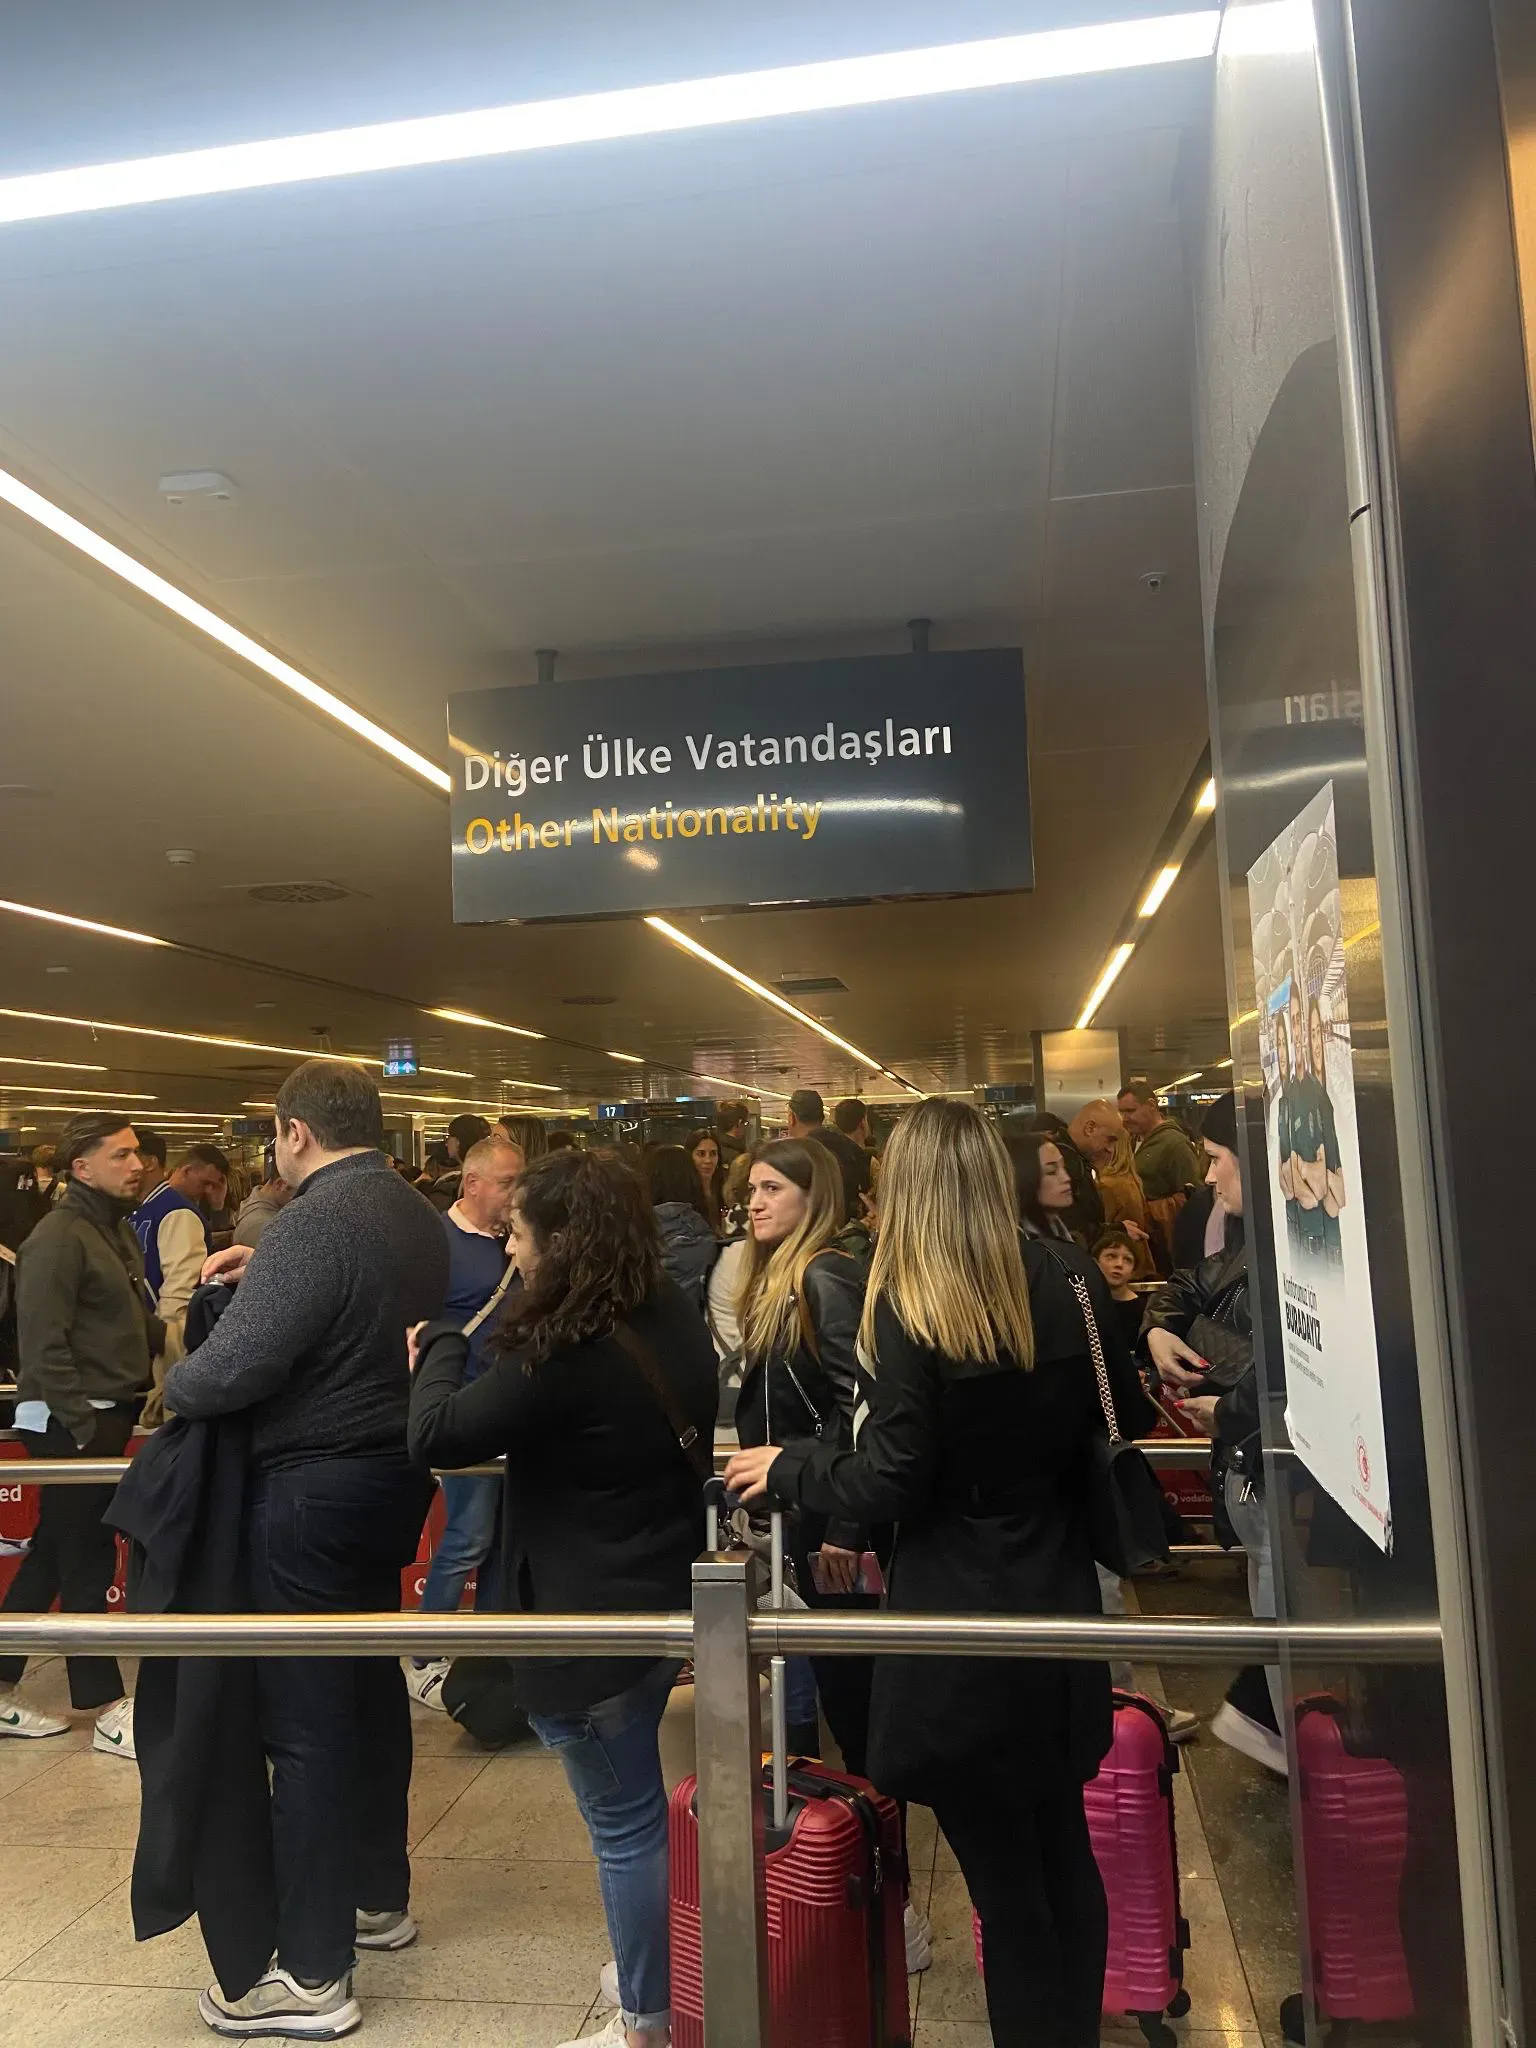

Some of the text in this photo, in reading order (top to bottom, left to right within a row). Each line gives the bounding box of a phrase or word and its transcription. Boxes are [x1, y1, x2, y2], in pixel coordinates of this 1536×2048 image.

[465, 718, 951, 796] Diğer Ülke Vatandaşları
[466, 793, 823, 854] Other Nationality
[605, 1106, 616, 1117] 17
[1157, 1096, 1168, 1106] 23
[1285, 1301, 1322, 1352] BURADAYIZ
